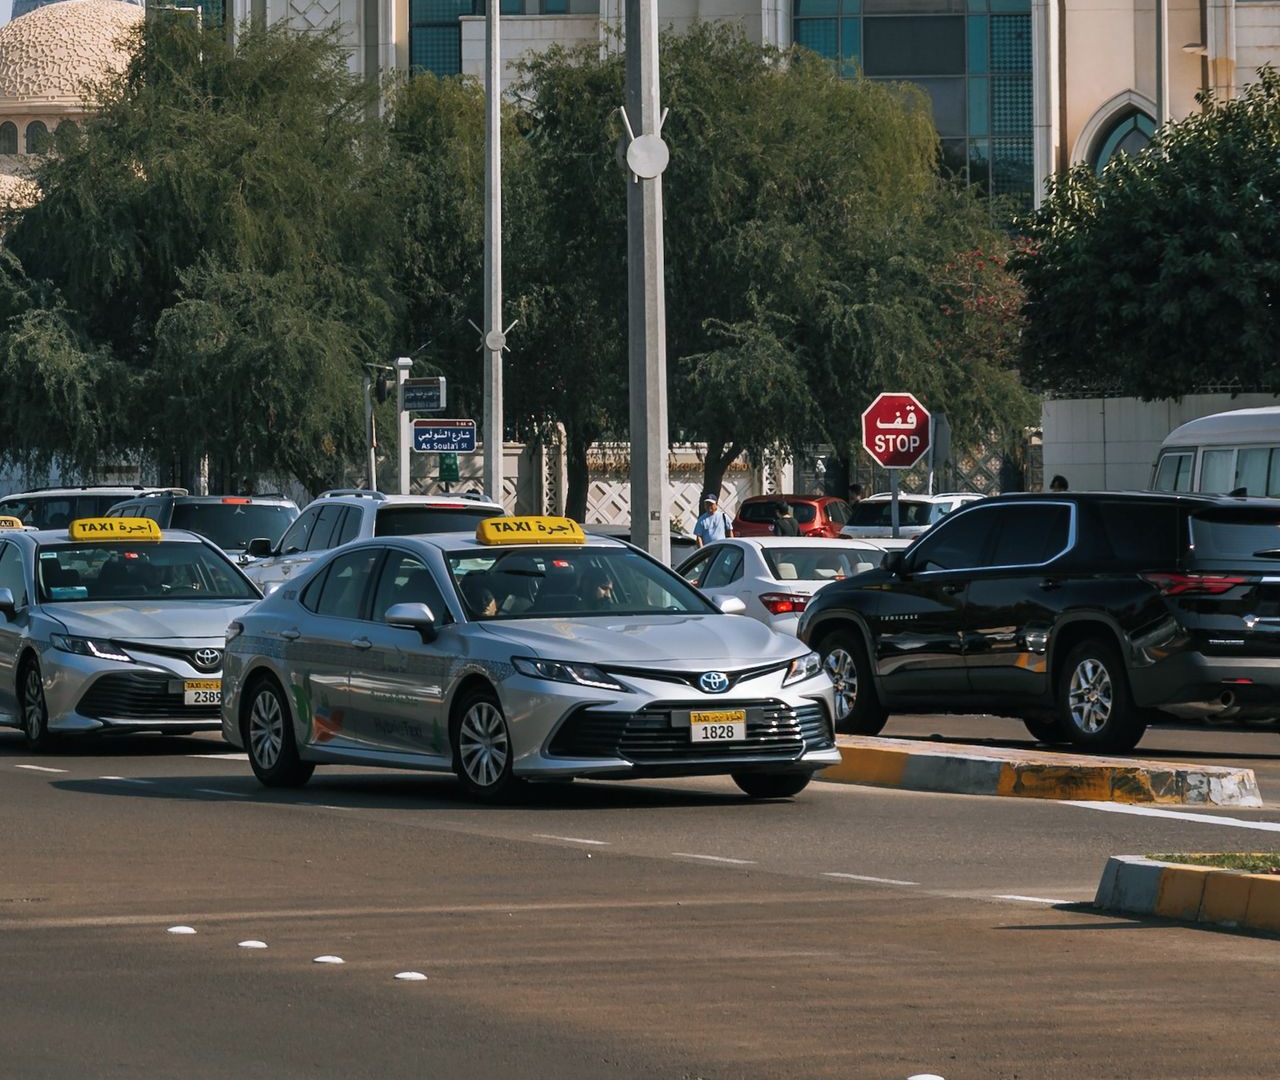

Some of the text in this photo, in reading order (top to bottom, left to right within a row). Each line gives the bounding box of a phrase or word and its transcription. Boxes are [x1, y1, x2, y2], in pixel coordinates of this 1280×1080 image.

[876, 405, 917, 429] قف
[451, 431, 471, 442] شارع
[874, 434, 920, 452] STOP
[421, 442, 431, 450] As
[79, 522, 114, 531] TAXI
[119, 520, 152, 534] أجرة
[490, 521, 532, 533] TAXI
[536, 520, 575, 535] أجرة
[193, 691, 222, 703] 2389
[702, 725, 734, 740] 1828
